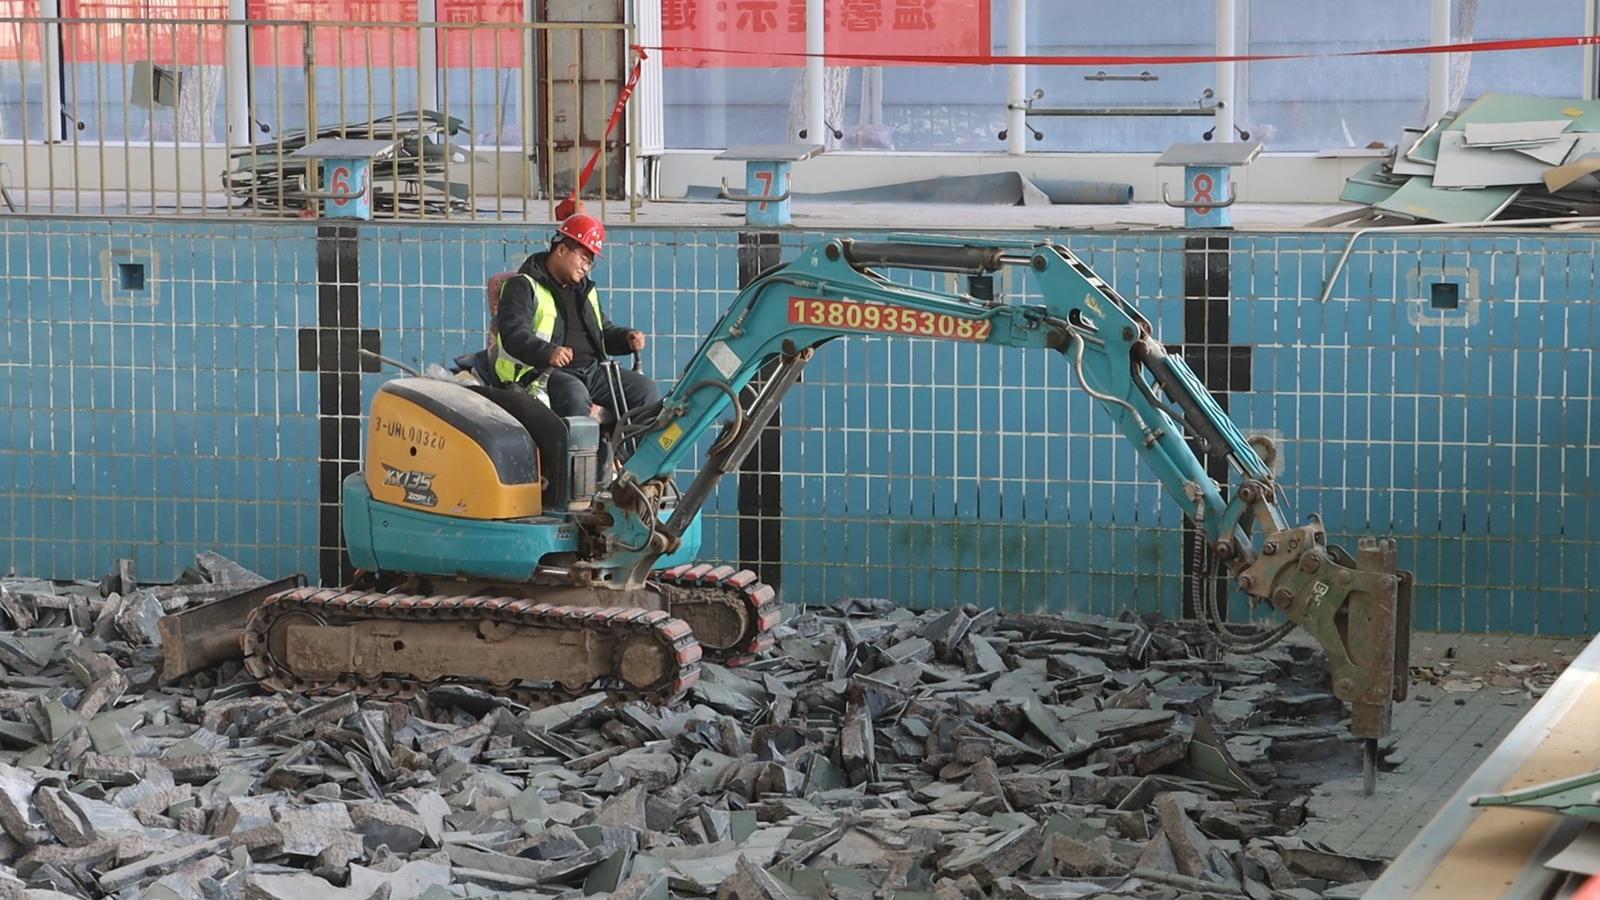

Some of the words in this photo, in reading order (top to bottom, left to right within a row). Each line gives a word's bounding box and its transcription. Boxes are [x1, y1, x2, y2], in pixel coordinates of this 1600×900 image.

[331, 166, 350, 207] 6
[754, 170, 773, 212] 7
[1192, 172, 1214, 216] 8
[793, 300, 991, 339] 13809353082
